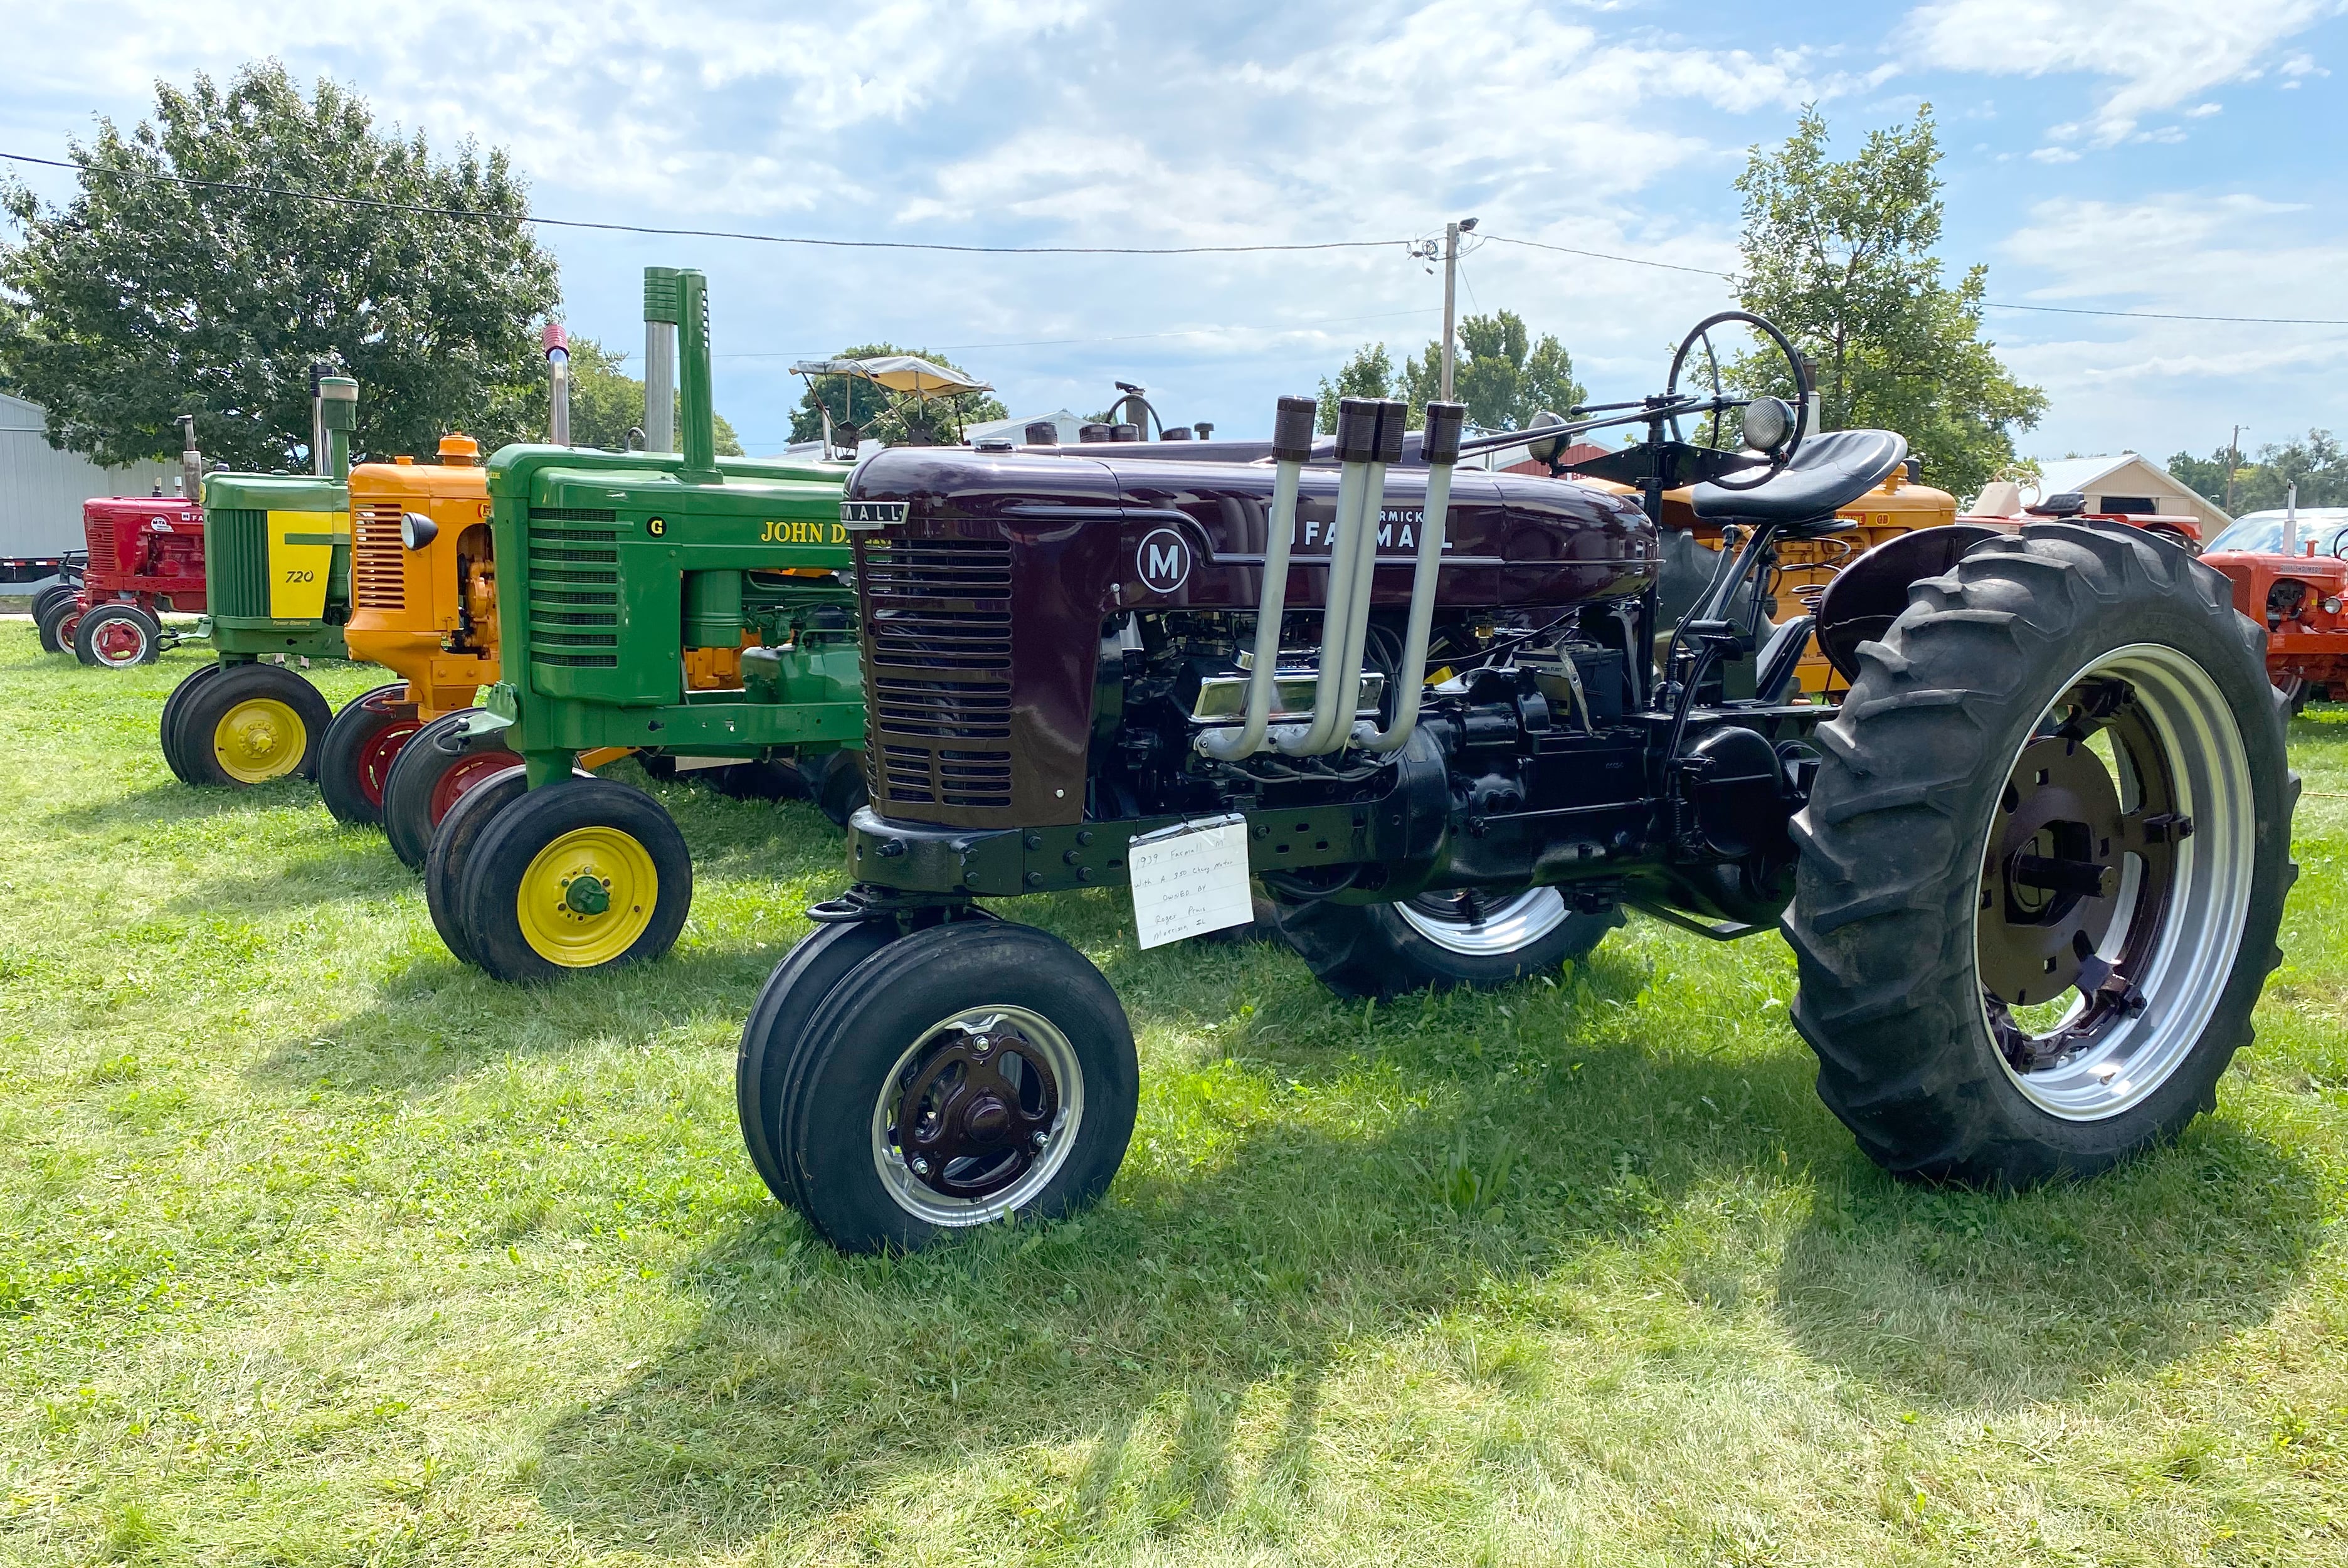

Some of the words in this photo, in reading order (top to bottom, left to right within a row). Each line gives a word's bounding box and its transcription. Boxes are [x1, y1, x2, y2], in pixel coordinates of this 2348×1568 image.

[1380, 510, 1423, 523] RMICK
[651, 520, 663, 534] G
[761, 521, 825, 544] JOHN
[1304, 521, 1453, 549] FAMAL
[1148, 543, 1179, 580] M
[285, 570, 314, 583] 720
[1135, 854, 1158, 871] 1939
[1170, 843, 1202, 860] Farmall
[1134, 878, 1153, 888] With
[1173, 870, 1187, 879] 350
[1214, 860, 1233, 870] Motor
[1163, 890, 1190, 901] OWNED
[1197, 883, 1207, 892] BY
[1155, 914, 1177, 925] Roger
